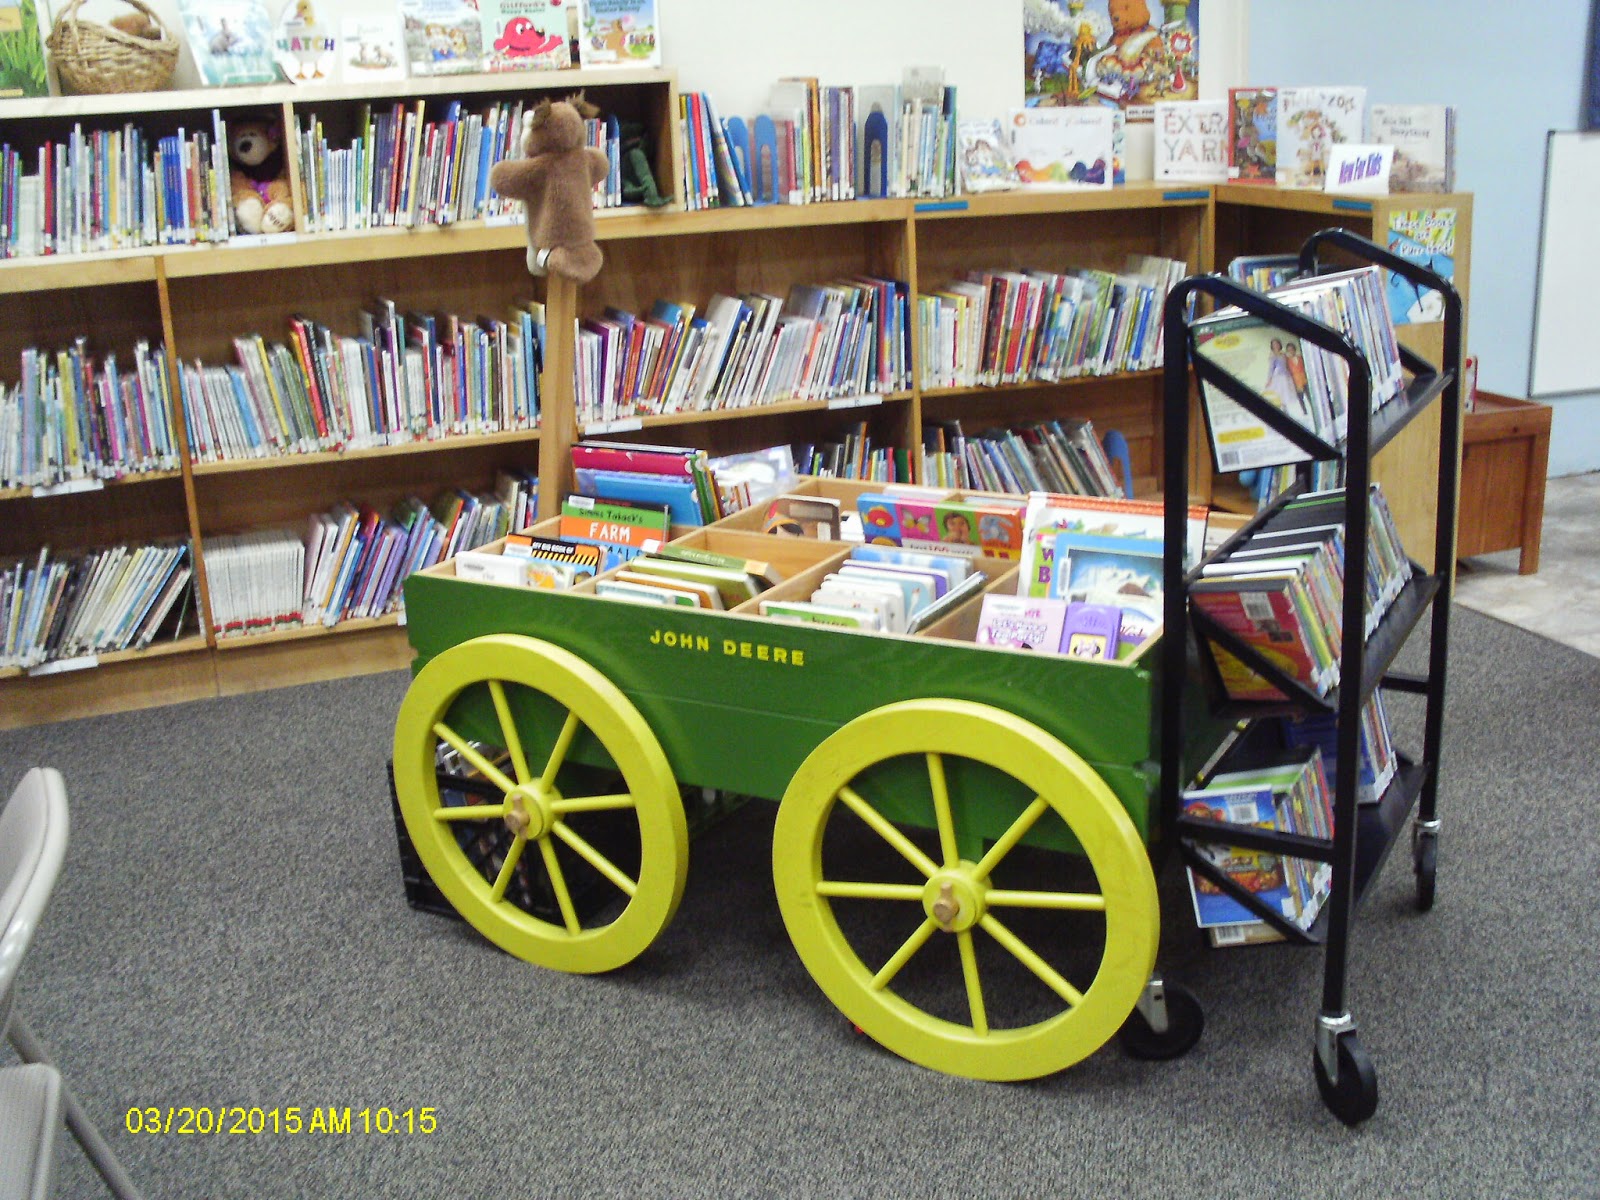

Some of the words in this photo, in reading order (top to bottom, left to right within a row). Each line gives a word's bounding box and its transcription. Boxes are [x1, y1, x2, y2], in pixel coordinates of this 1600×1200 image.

[589, 521, 631, 543] FARM
[650, 629, 709, 652] JOHN
[723, 639, 804, 667] DEERE
